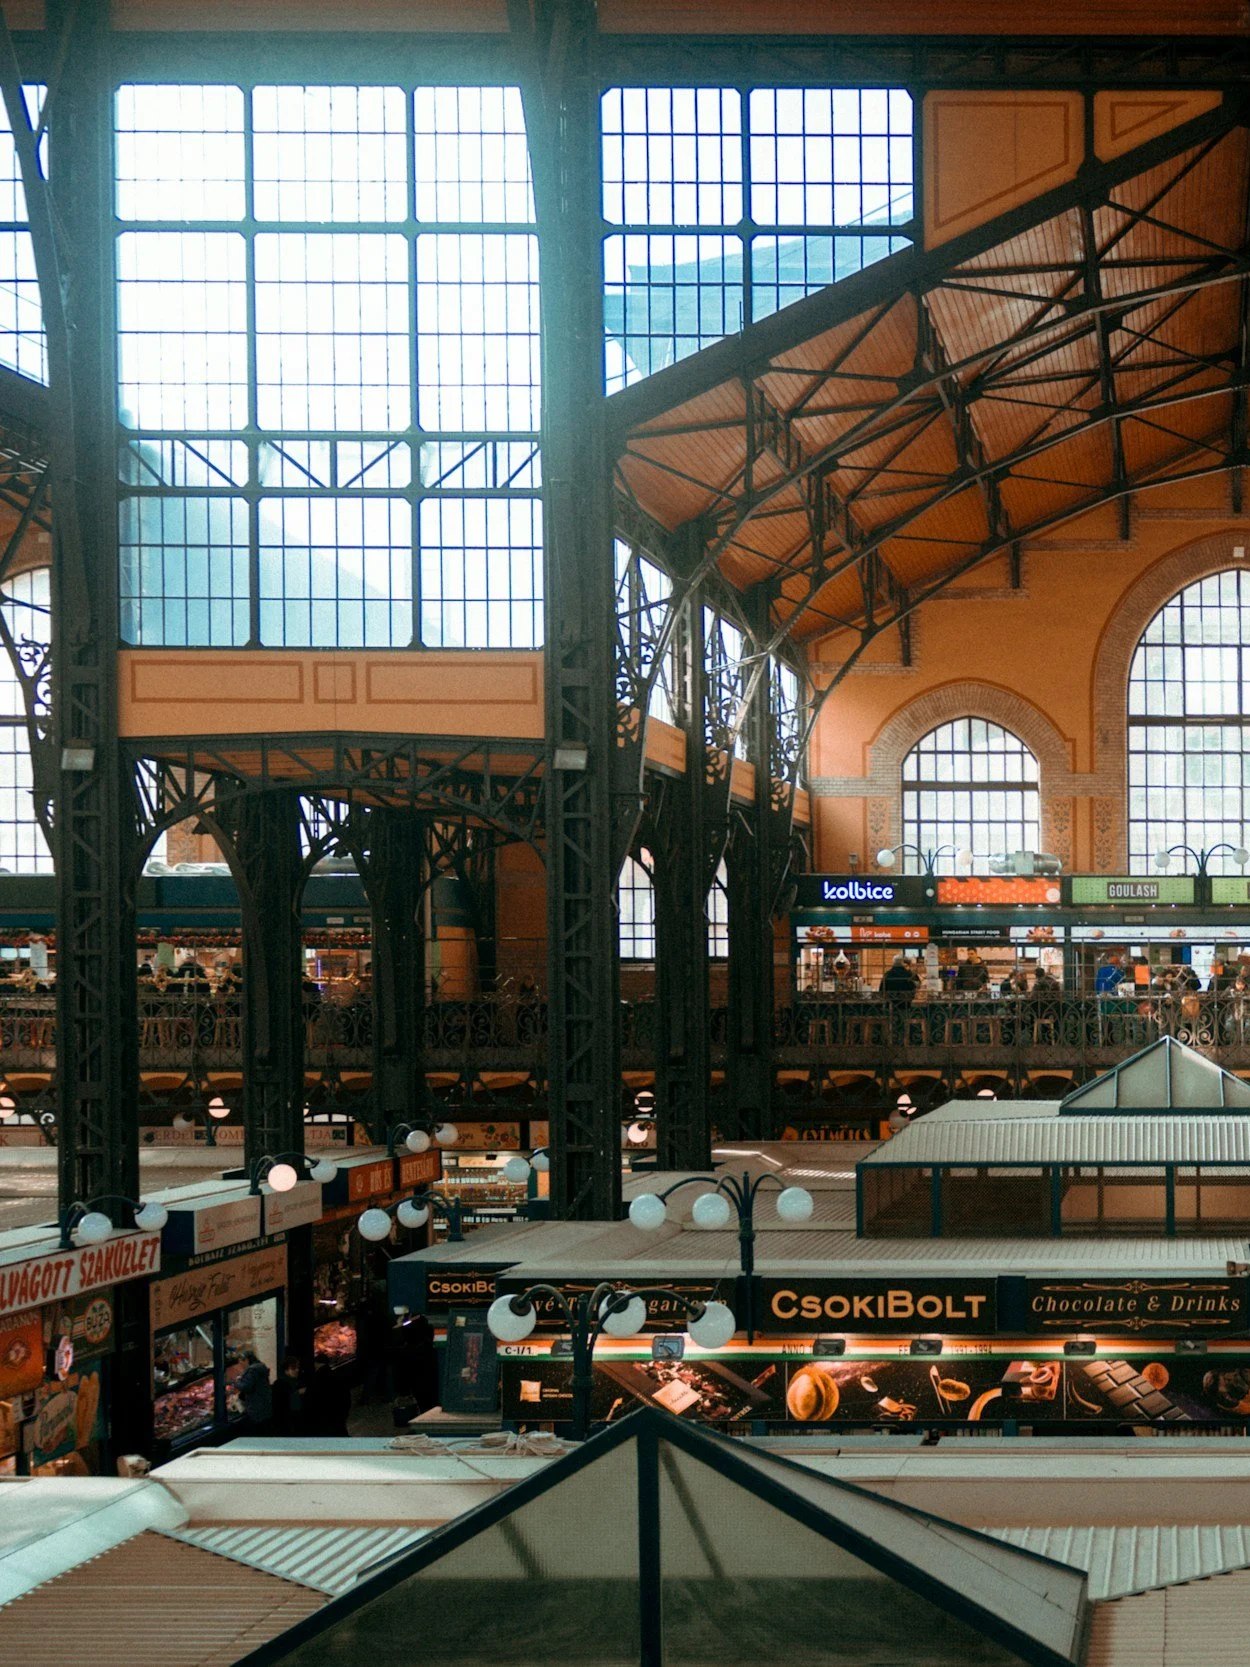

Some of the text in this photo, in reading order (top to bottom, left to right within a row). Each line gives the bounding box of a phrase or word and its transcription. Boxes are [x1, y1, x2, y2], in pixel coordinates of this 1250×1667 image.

[823, 881, 893, 900] kolbice
[1109, 884, 1158, 897] GOULASH
[79, 1236, 160, 1288] SZAKÜZLET
[1031, 1295, 1240, 1312] Chocolate & Drinks
